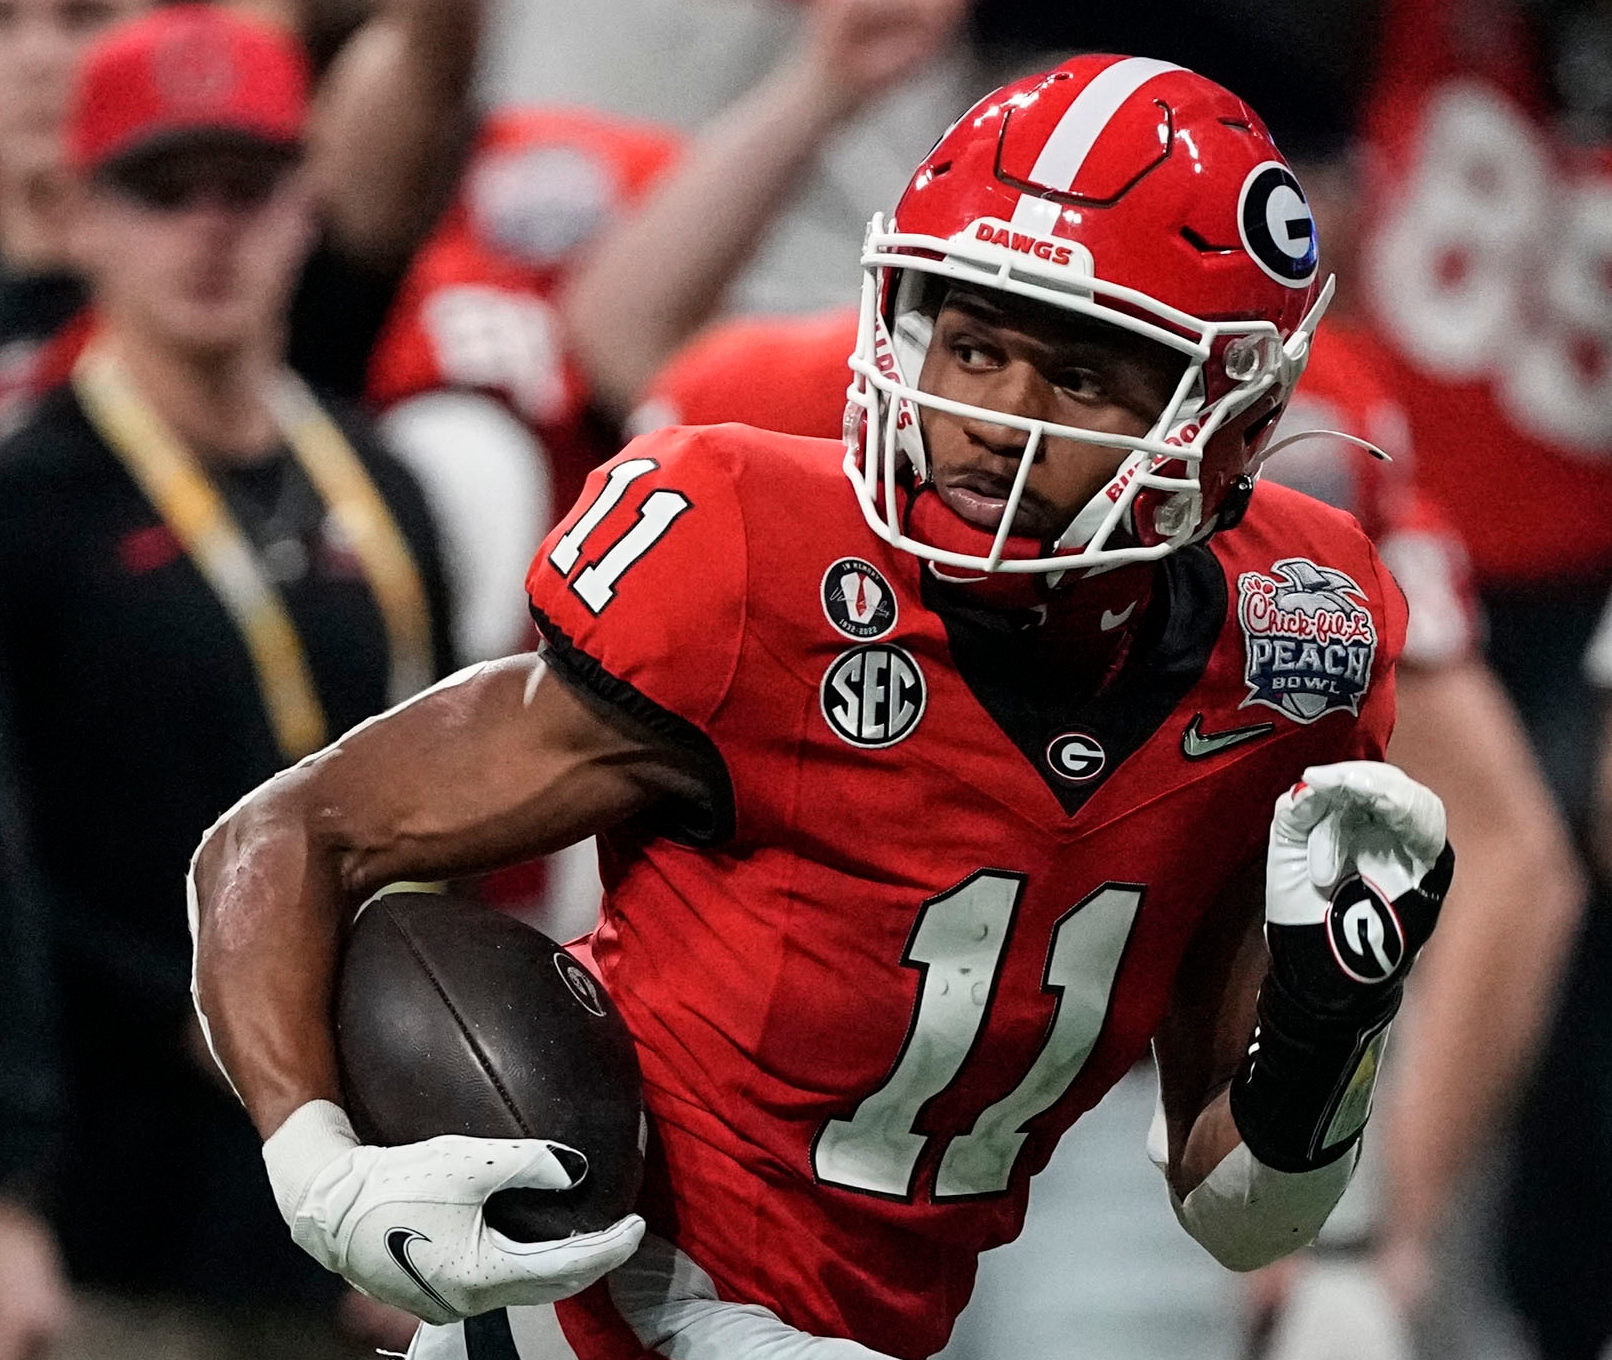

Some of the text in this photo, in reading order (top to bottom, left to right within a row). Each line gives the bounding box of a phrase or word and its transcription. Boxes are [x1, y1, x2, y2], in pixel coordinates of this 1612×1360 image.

[975, 222, 1073, 266] DAWGS
[1242, 167, 1317, 280] G
[548, 457, 695, 618] 11
[1246, 590, 1371, 643] Chick-fil-A
[1250, 638, 1370, 684] PEACH
[1271, 676, 1340, 694] BOWL
[831, 650, 917, 740] SEC
[1048, 734, 1104, 778] G
[810, 867, 1146, 1203] 11
